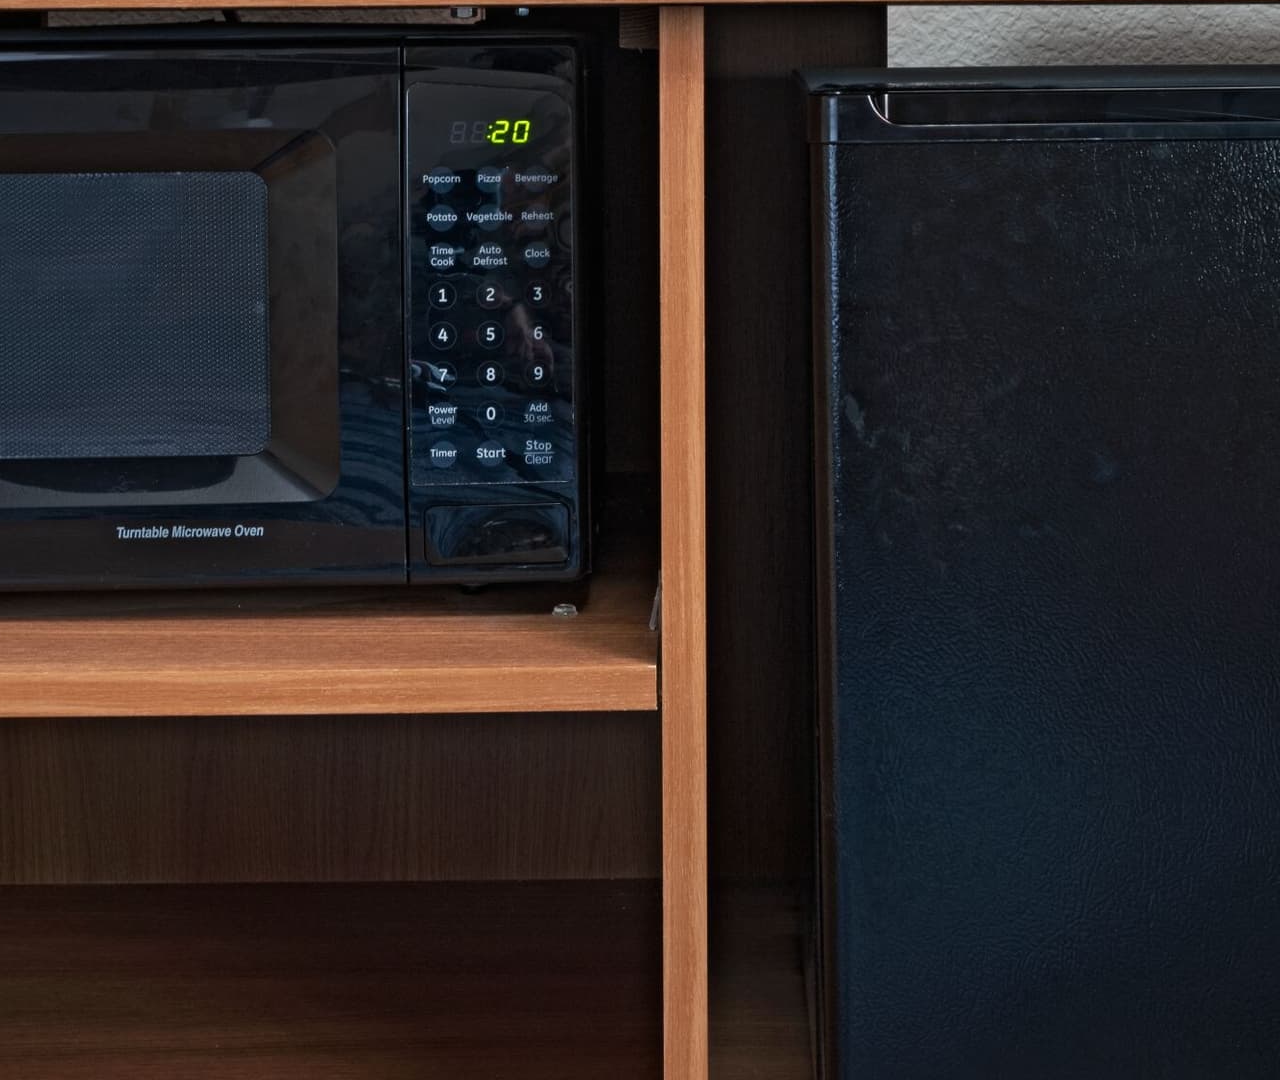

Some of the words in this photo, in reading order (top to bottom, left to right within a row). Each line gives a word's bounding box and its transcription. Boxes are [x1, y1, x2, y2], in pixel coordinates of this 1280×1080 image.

[423, 174, 461, 184] Popcorn
[515, 174, 558, 184] Beverage
[427, 213, 458, 222] Potato
[467, 212, 513, 222] Vegetable
[521, 212, 554, 220] Reheat
[431, 246, 454, 255] Time
[479, 246, 501, 254] Auto
[525, 249, 550, 257] Clock
[431, 258, 454, 266] Cook
[473, 257, 507, 265] Defrost
[438, 289, 447, 303] 1
[486, 288, 495, 301] 2
[533, 288, 542, 301] 3
[438, 328, 448, 342] 4
[486, 328, 495, 341] 5
[534, 327, 543, 340] 6
[439, 369, 448, 382] 7
[486, 368, 496, 381] 8
[534, 367, 543, 380] 9
[429, 406, 457, 414] Power
[529, 403, 548, 412] Add
[486, 407, 496, 420] 0
[431, 416, 455, 425] Level
[524, 415, 535, 423] 30
[537, 415, 554, 423] sec.
[526, 441, 552, 452] Stop
[430, 449, 457, 457] Timer
[476, 448, 506, 458] Start
[525, 454, 552, 464] Clear
[117, 526, 168, 539] Turntable
[172, 525, 231, 538] Microwave
[234, 524, 264, 537] Oven
